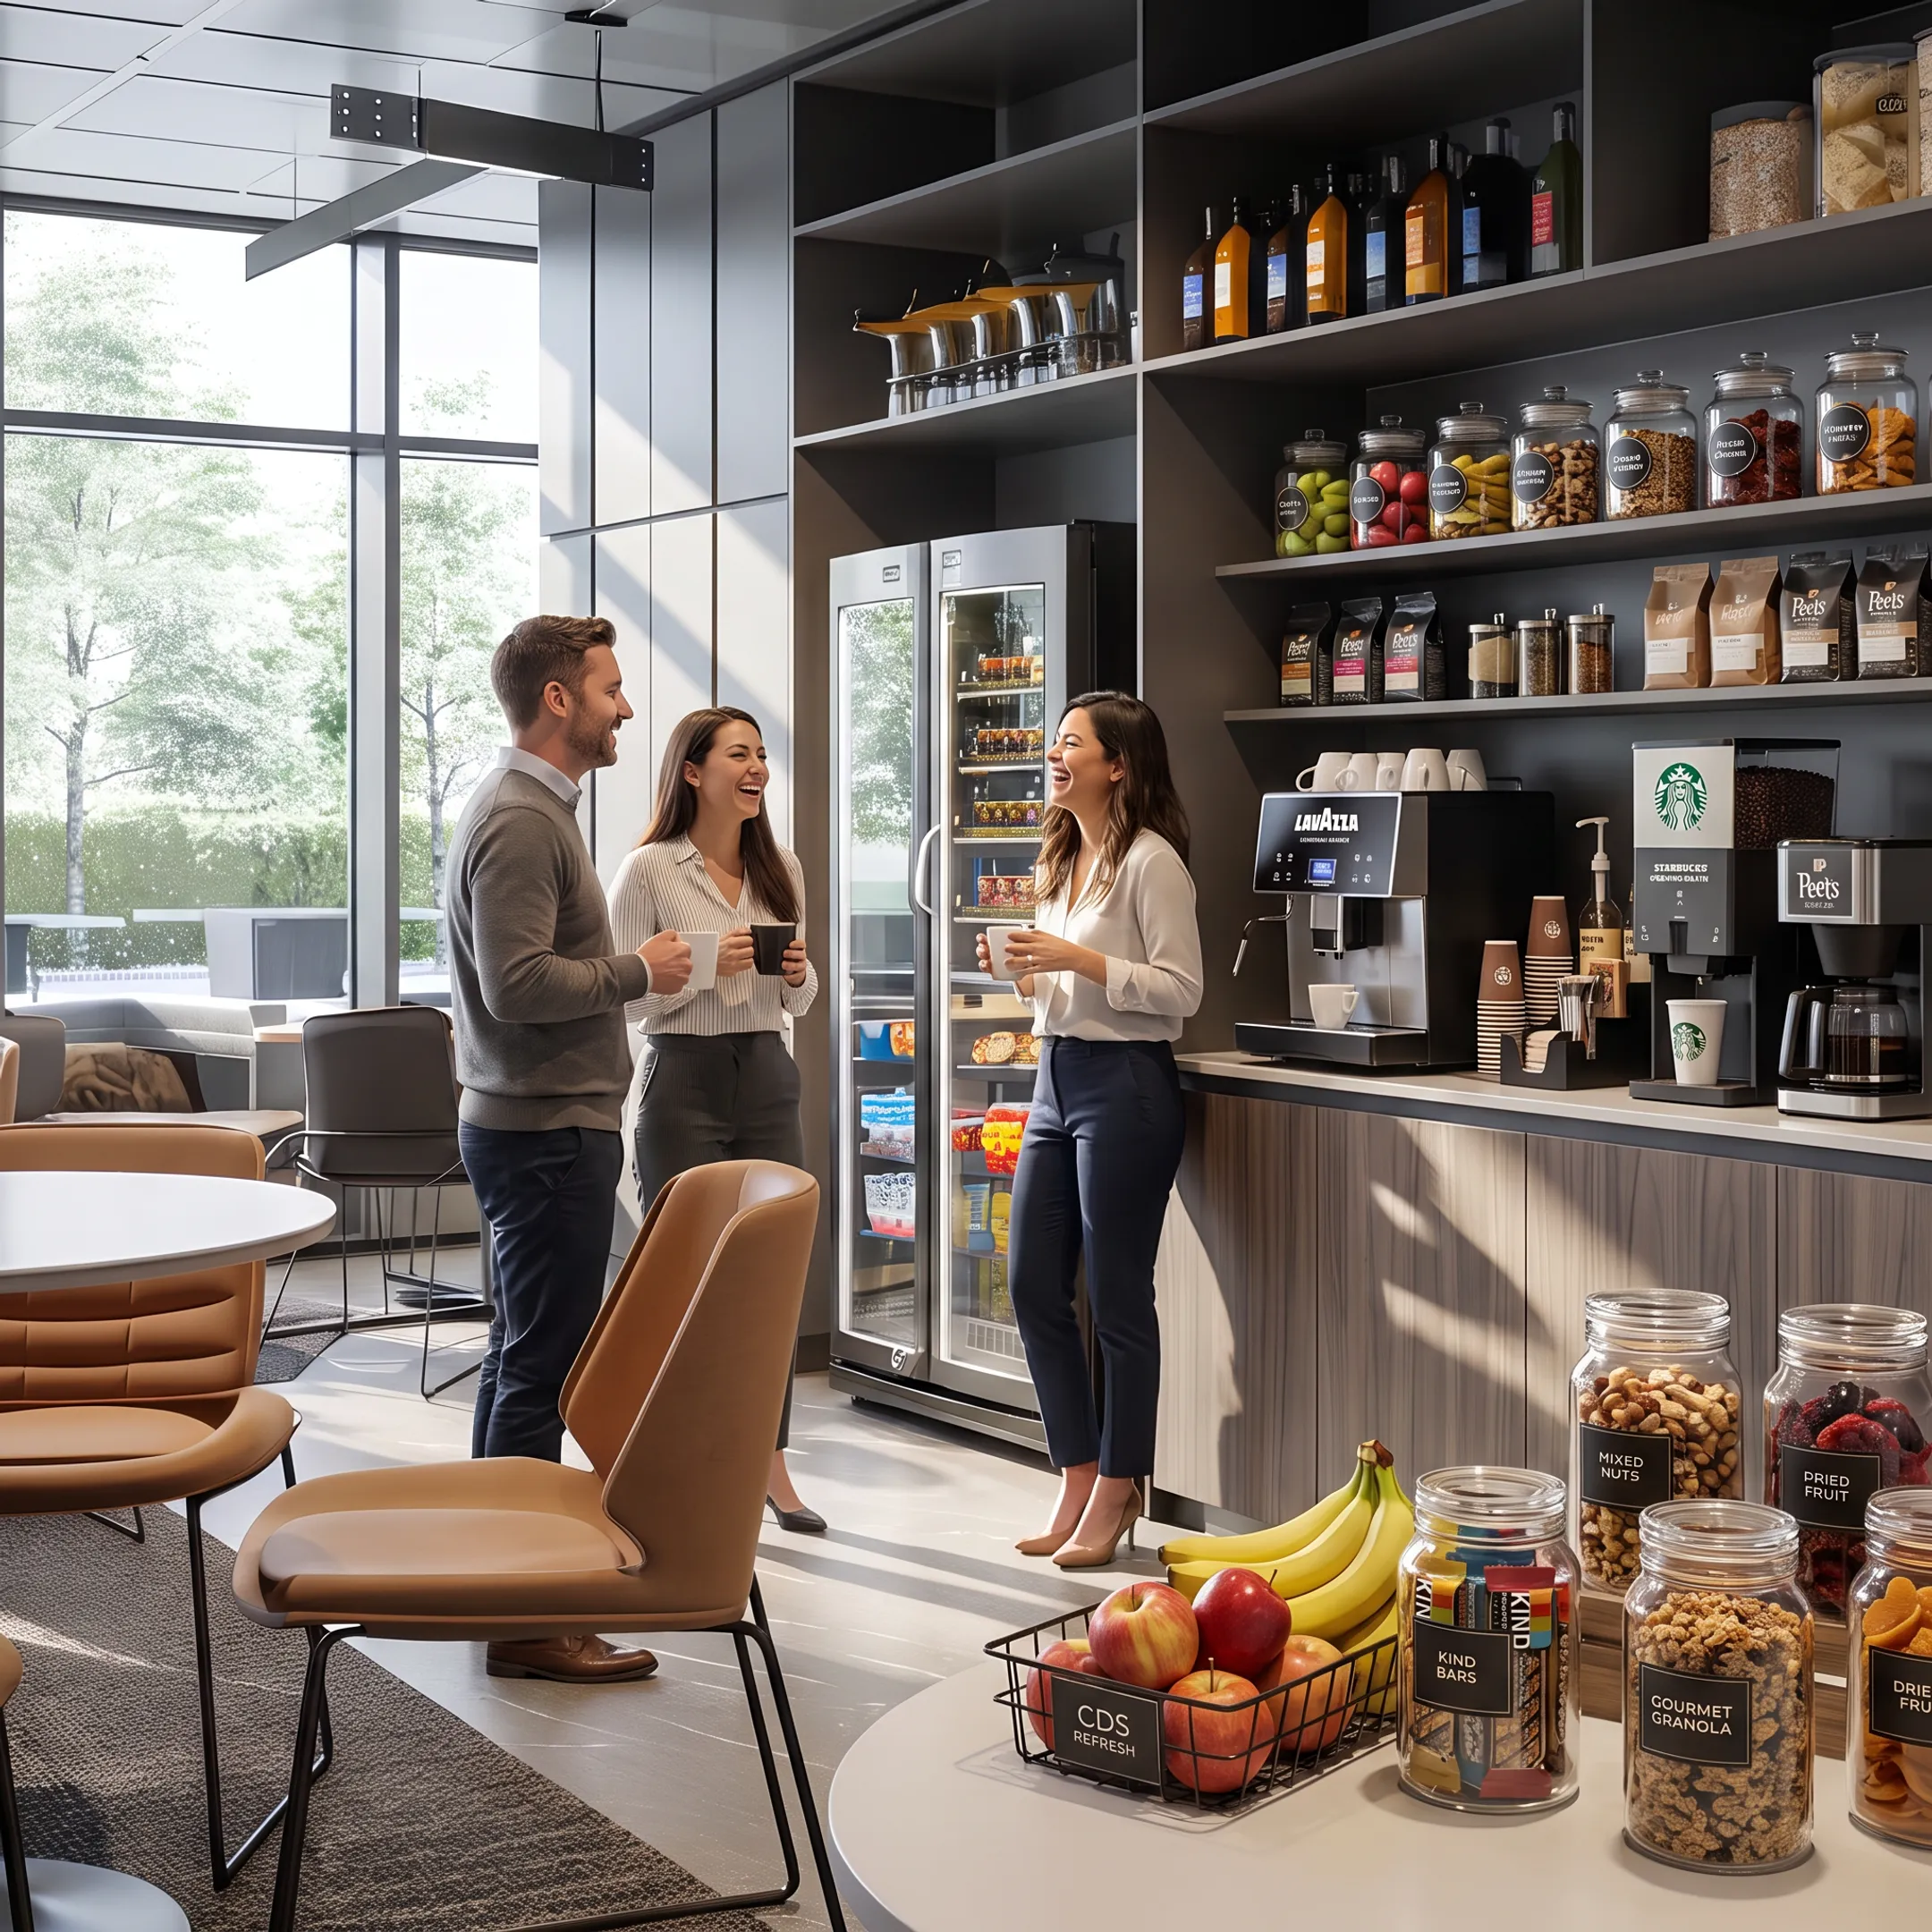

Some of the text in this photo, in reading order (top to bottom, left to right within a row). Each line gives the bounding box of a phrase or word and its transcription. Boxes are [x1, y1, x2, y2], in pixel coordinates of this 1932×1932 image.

[1293, 807, 1359, 832] LAVAZZA
[1654, 863, 1708, 873] STARBUCKS
[1598, 1451, 1644, 1468] MIXED
[1601, 1466, 1640, 1482] NUTS
[1805, 1485, 1850, 1502] FRUIT
[1511, 1592, 1530, 1649] KIND
[1438, 1650, 1477, 1668] KIND
[1436, 1665, 1477, 1684] BARS
[1894, 1680, 1932, 1699] DRIE
[1651, 1695, 1733, 1719] GOURMET
[1900, 1697, 1932, 1714] FRU
[1078, 1704, 1130, 1737] CDS
[1651, 1711, 1733, 1736] GRANOLA
[1073, 1730, 1135, 1758] REFRESH
